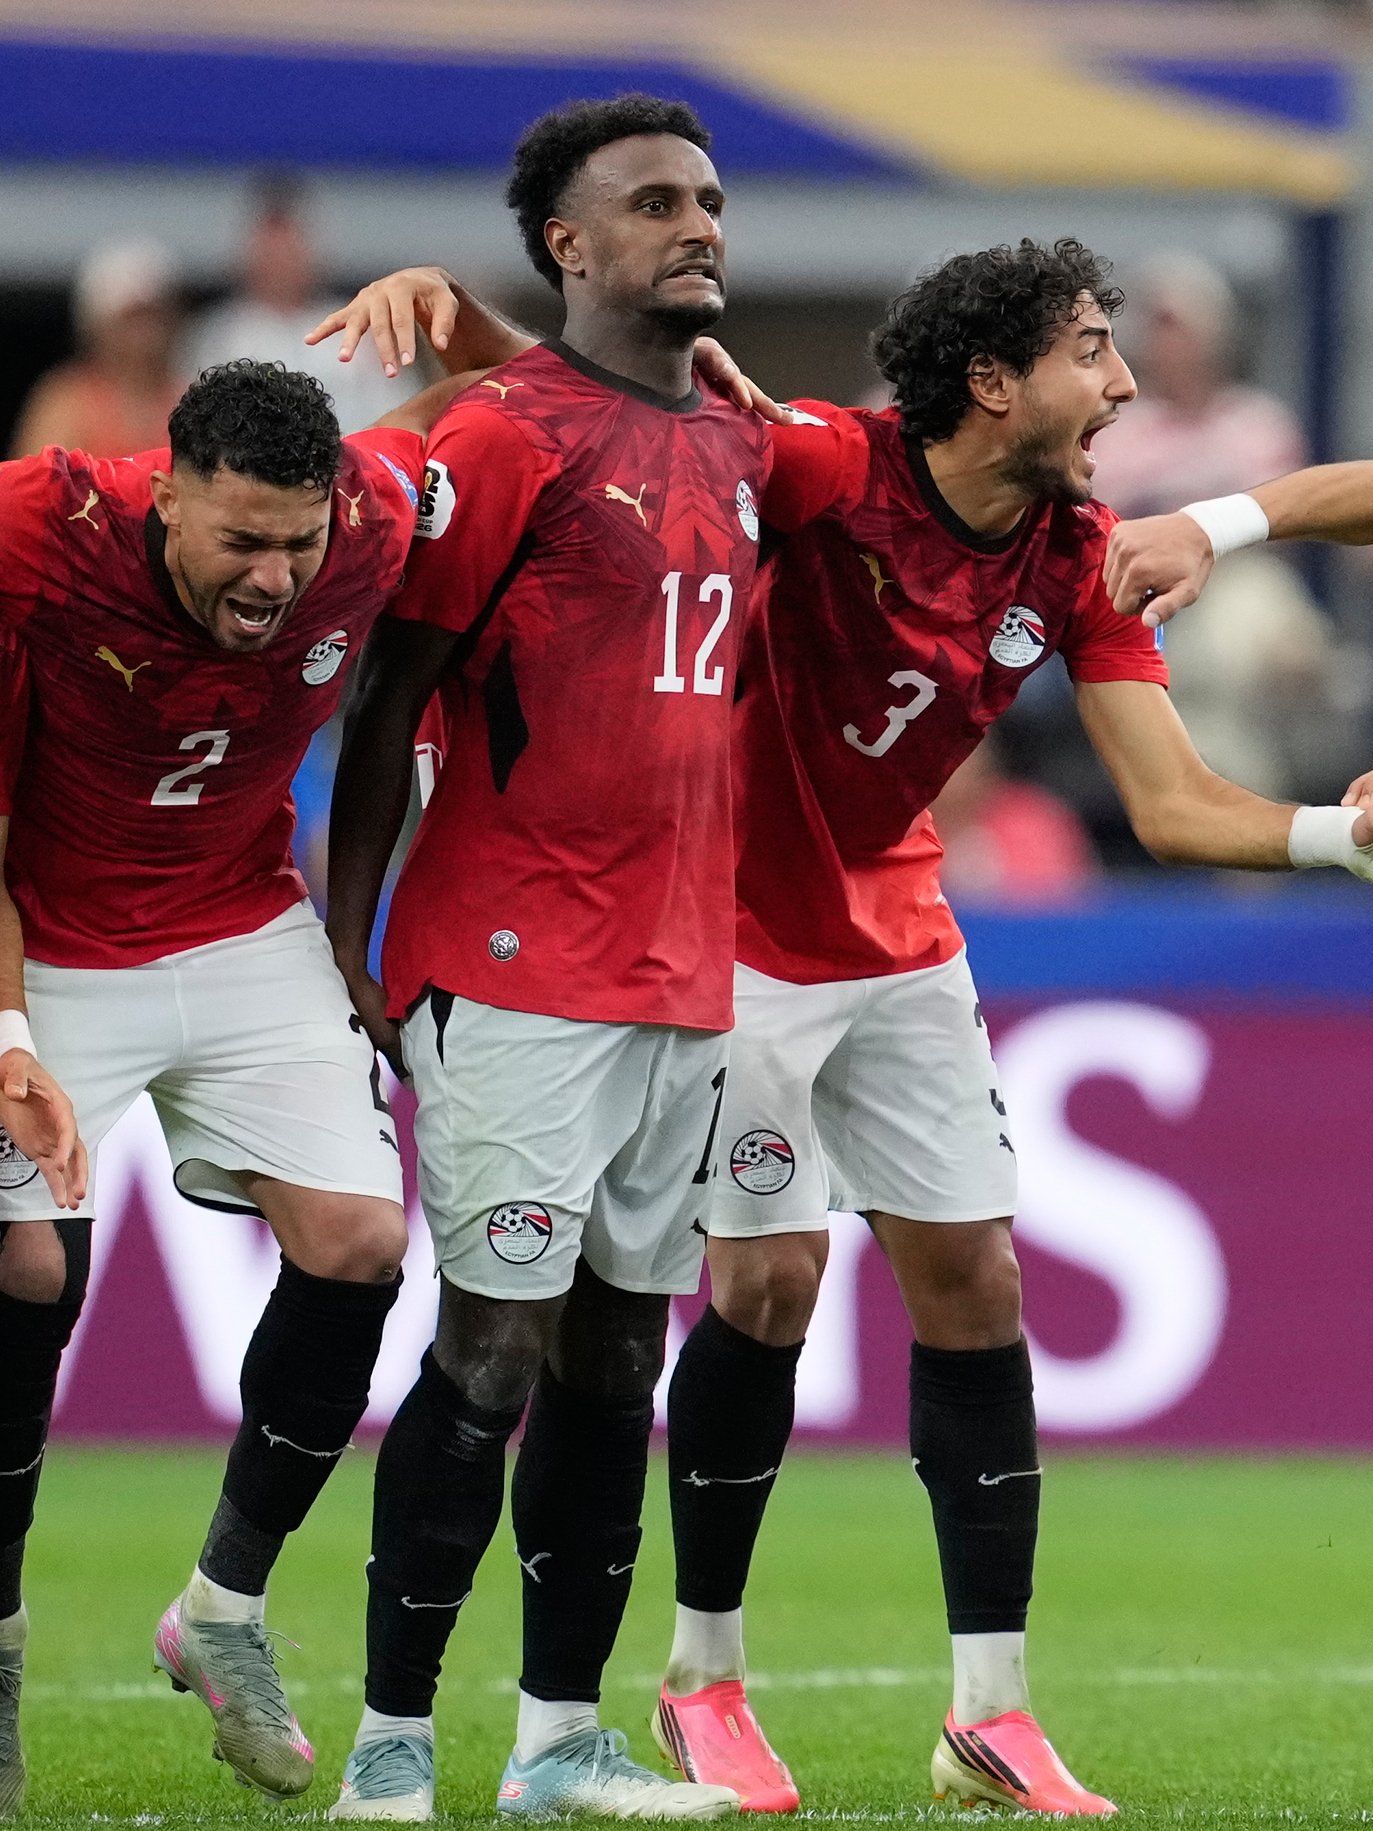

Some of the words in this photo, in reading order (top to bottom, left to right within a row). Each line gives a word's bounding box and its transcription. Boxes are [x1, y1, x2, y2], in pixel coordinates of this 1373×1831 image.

[652, 571, 733, 696] 12
[842, 669, 940, 758] 3
[150, 729, 231, 806] 2
